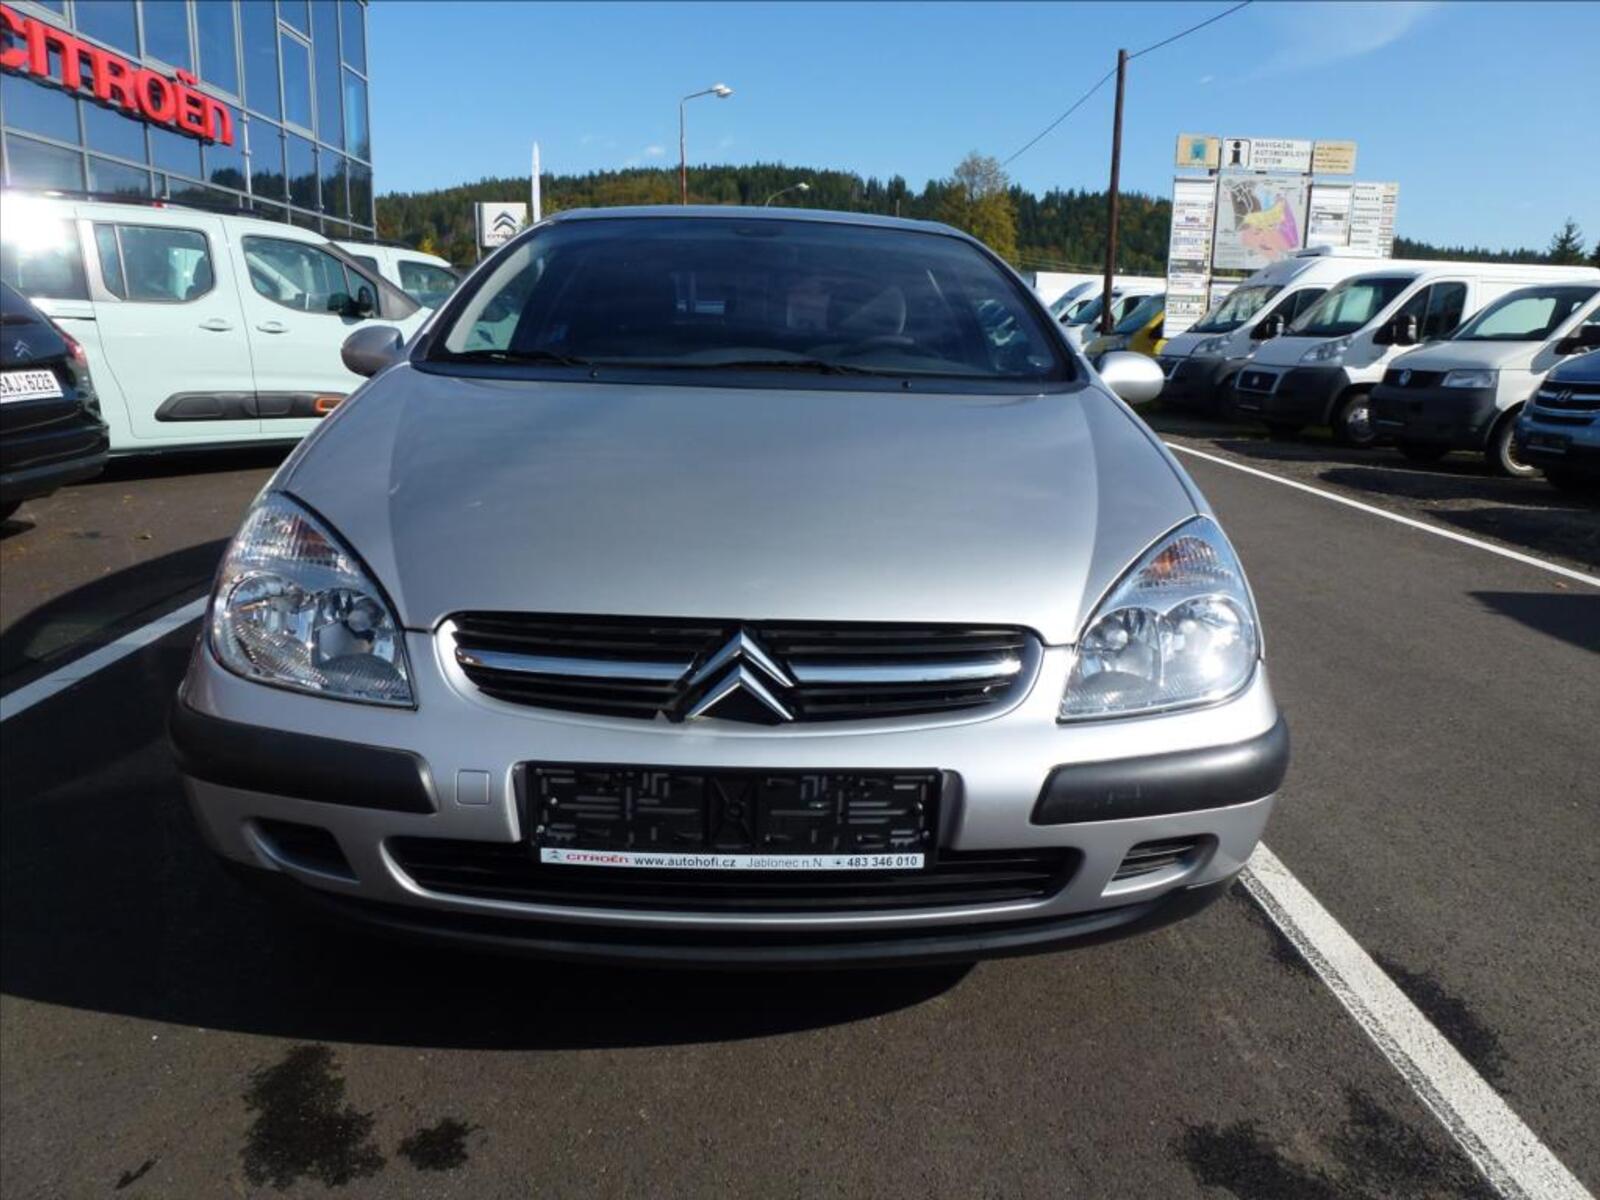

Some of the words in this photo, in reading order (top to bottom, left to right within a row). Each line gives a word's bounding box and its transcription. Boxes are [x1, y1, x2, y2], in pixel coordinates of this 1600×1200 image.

[634, 855, 737, 868] www.autohofi.cz
[746, 857, 798, 868] Jablonec
[847, 856, 868, 867] 483
[872, 856, 892, 867] 346
[896, 855, 918, 867] 010
